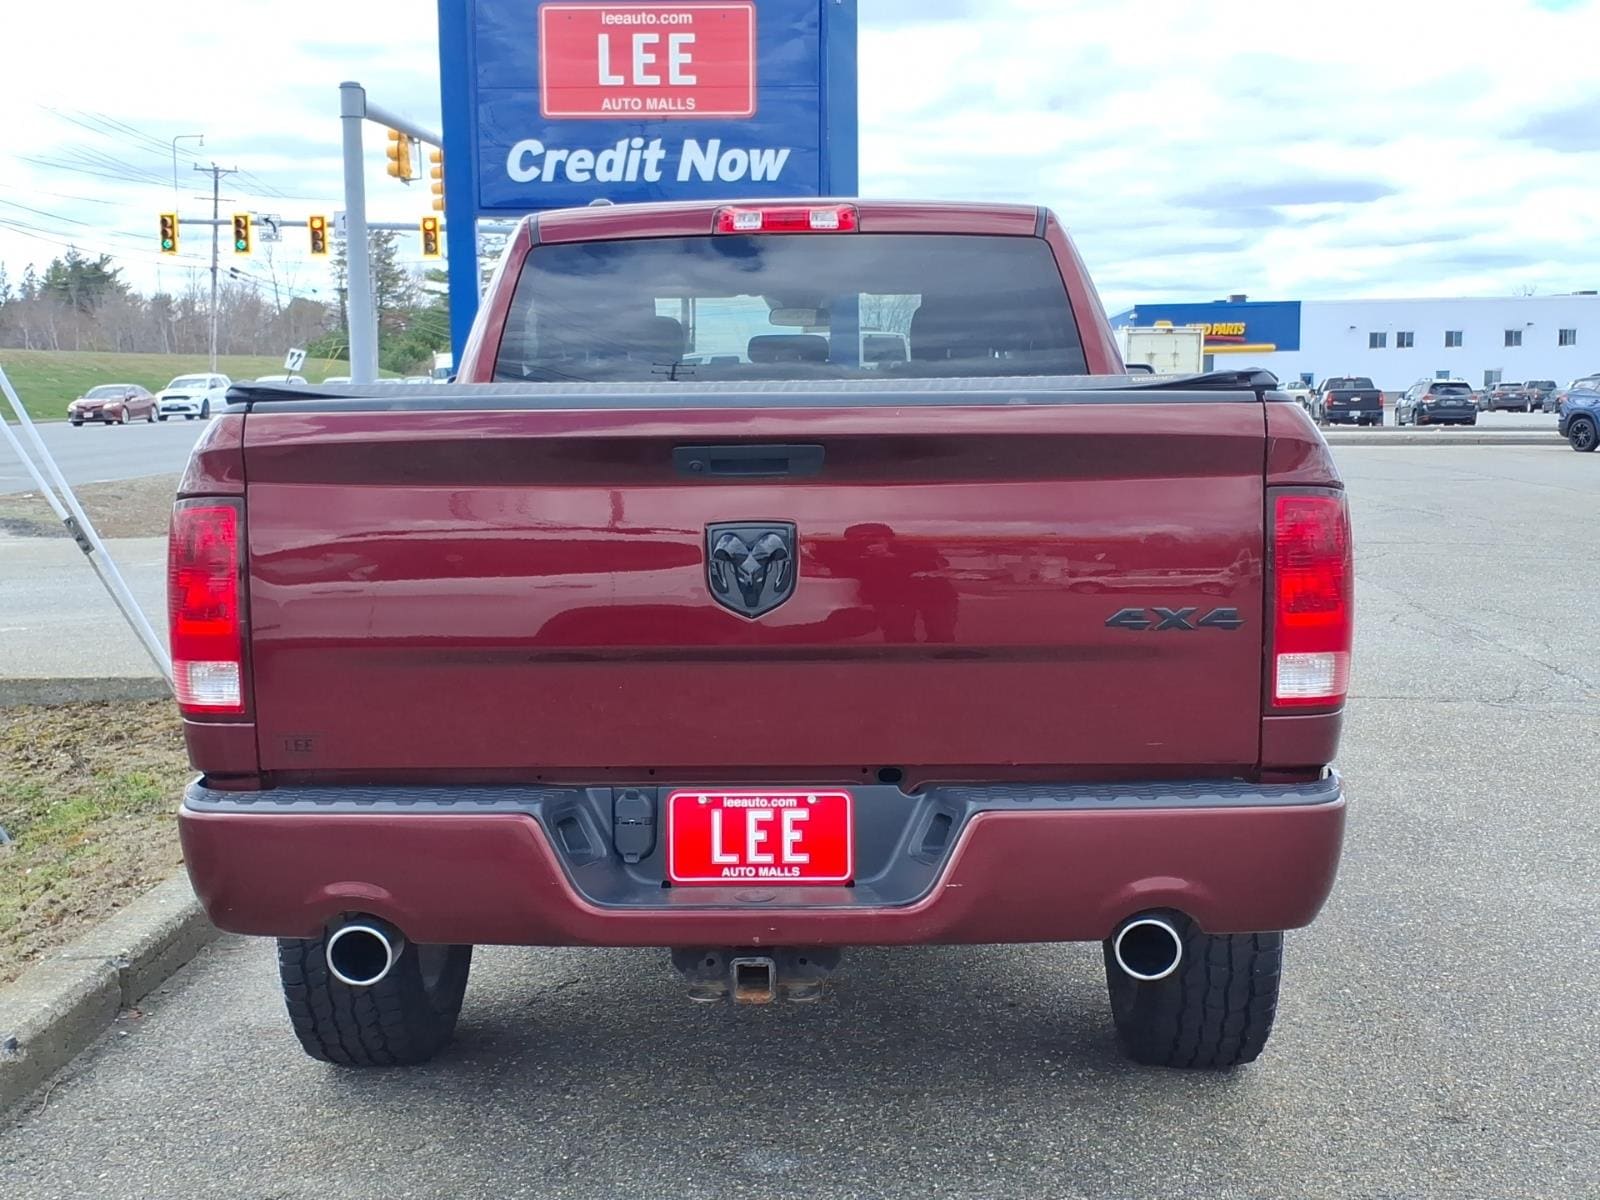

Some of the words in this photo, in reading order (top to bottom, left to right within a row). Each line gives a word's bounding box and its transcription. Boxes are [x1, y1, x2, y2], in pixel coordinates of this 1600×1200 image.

[601, 11, 693, 25] leeauto.com
[598, 33, 697, 86] LEE
[602, 98, 641, 110] AUTO
[646, 98, 696, 110] MALLS
[506, 137, 667, 183] Credit
[677, 138, 791, 182] Now
[1212, 322, 1246, 335] PARTS
[723, 796, 797, 808] leeauto.com
[711, 808, 810, 864] LEE
[722, 867, 756, 877] AUTO
[758, 866, 801, 877] MALLS
